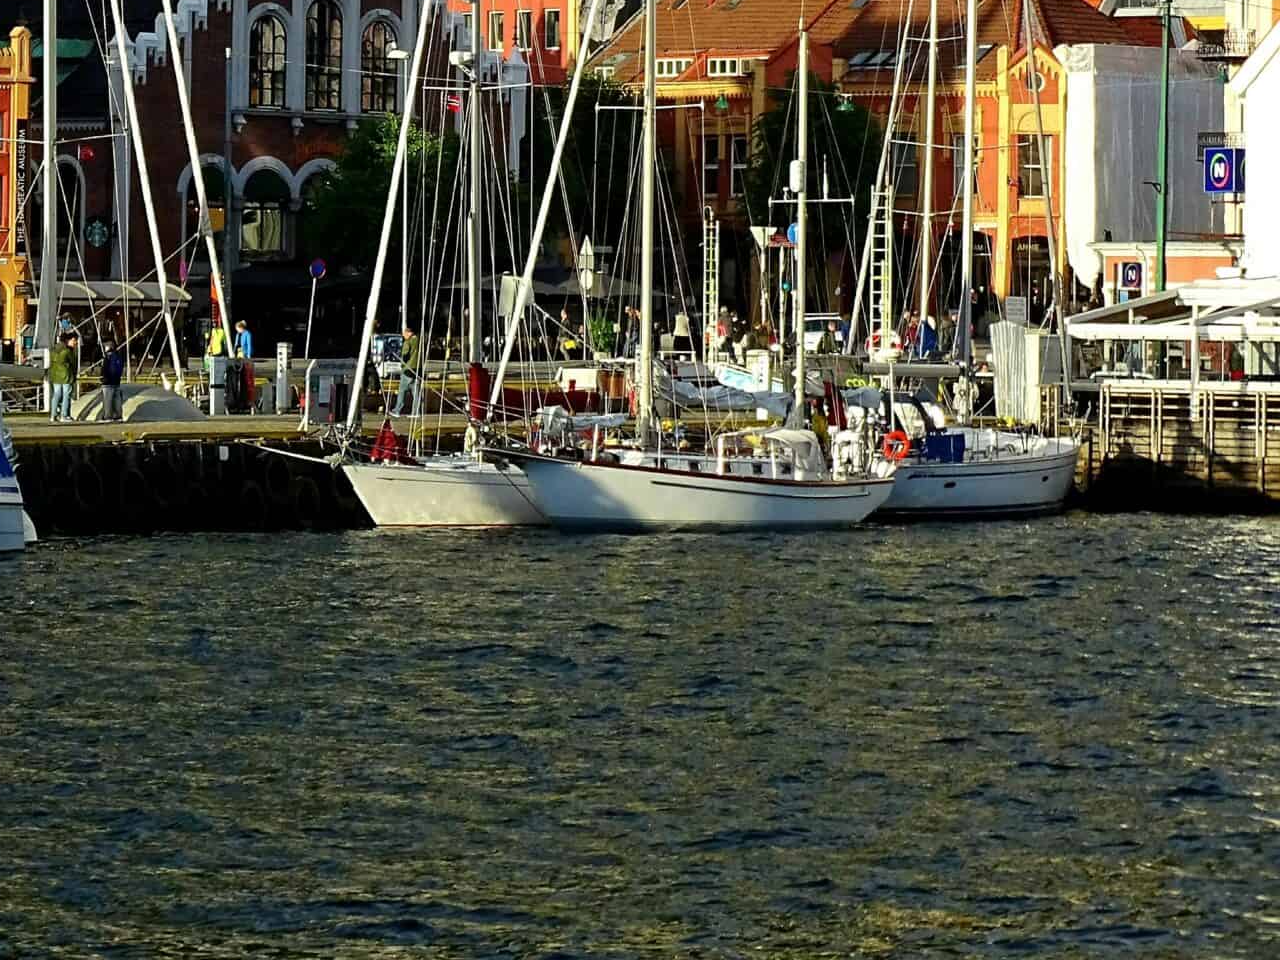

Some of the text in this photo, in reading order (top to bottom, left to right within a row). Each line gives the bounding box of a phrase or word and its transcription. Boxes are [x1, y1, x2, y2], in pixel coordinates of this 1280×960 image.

[18, 129, 26, 169] MUSEUM
[1213, 162, 1225, 179] N
[17, 226, 25, 243] THE
